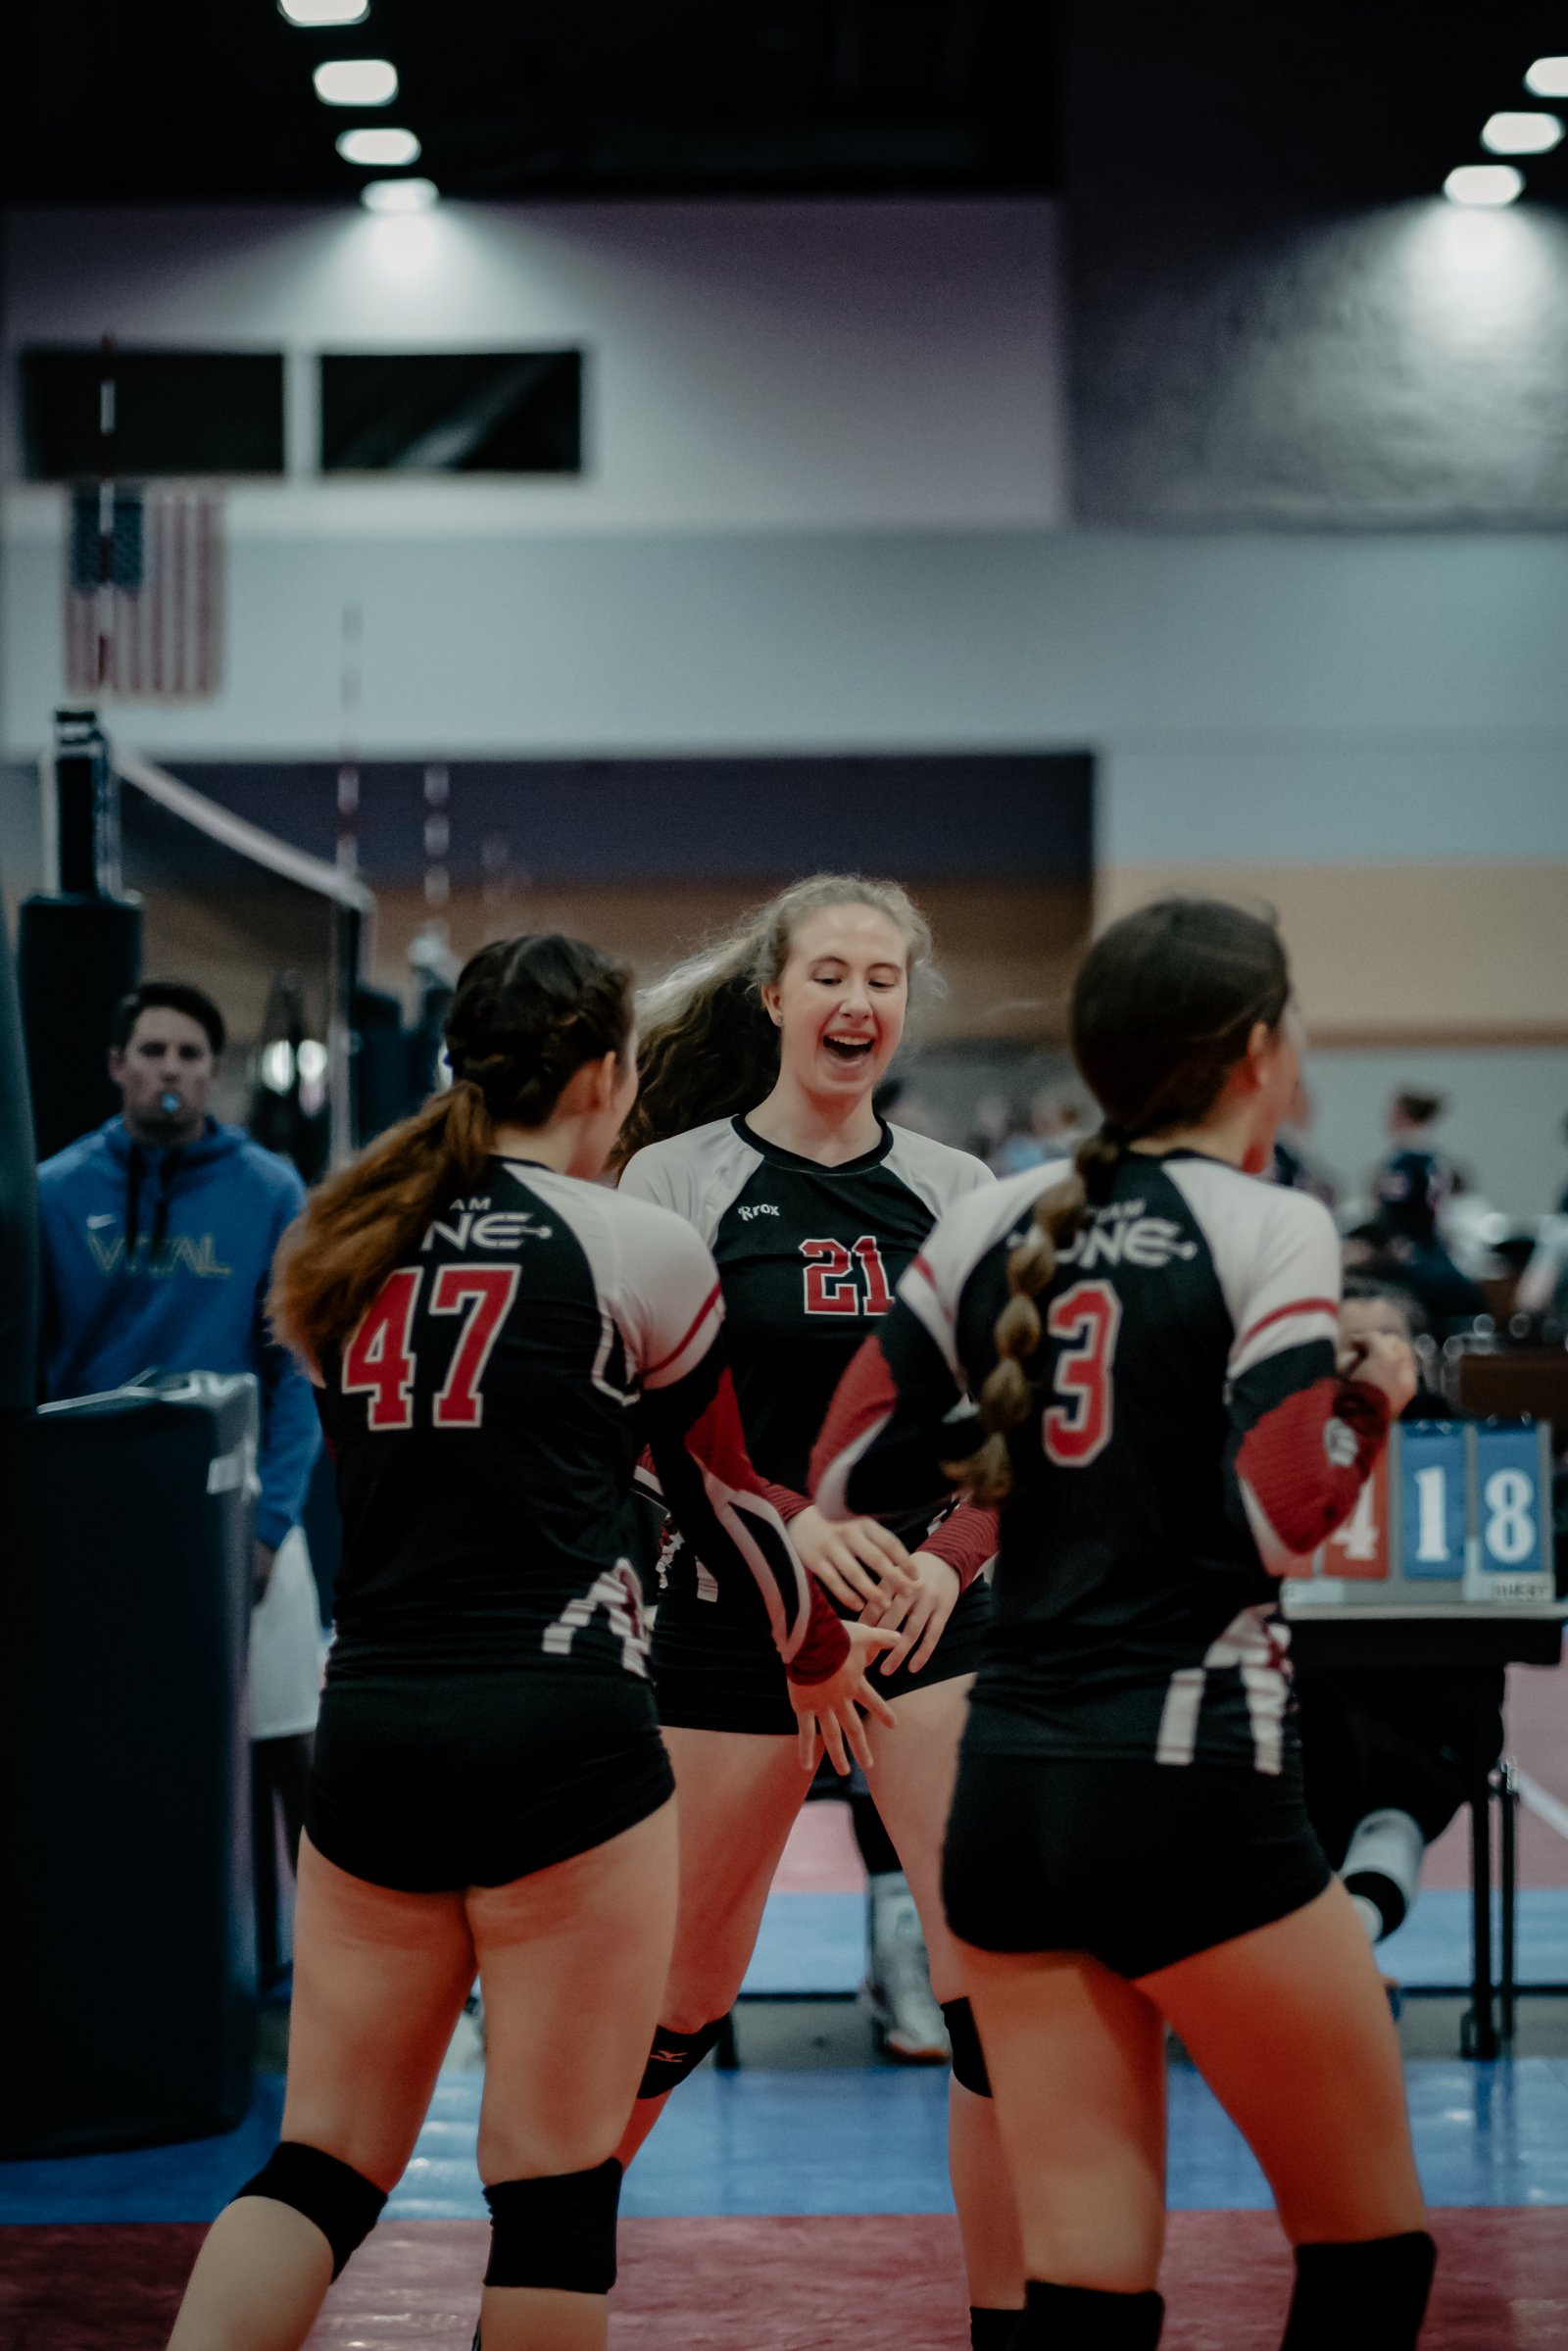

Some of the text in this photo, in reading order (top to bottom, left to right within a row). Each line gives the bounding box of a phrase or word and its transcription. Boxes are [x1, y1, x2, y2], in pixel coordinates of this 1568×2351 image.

[420, 1211, 536, 1251] NE
[449, 1197, 492, 1211] AM
[737, 1203, 780, 1222] Rrox
[798, 1235, 896, 1316] 21
[342, 1263, 521, 1432] 47
[1043, 1278, 1123, 1468] 3
